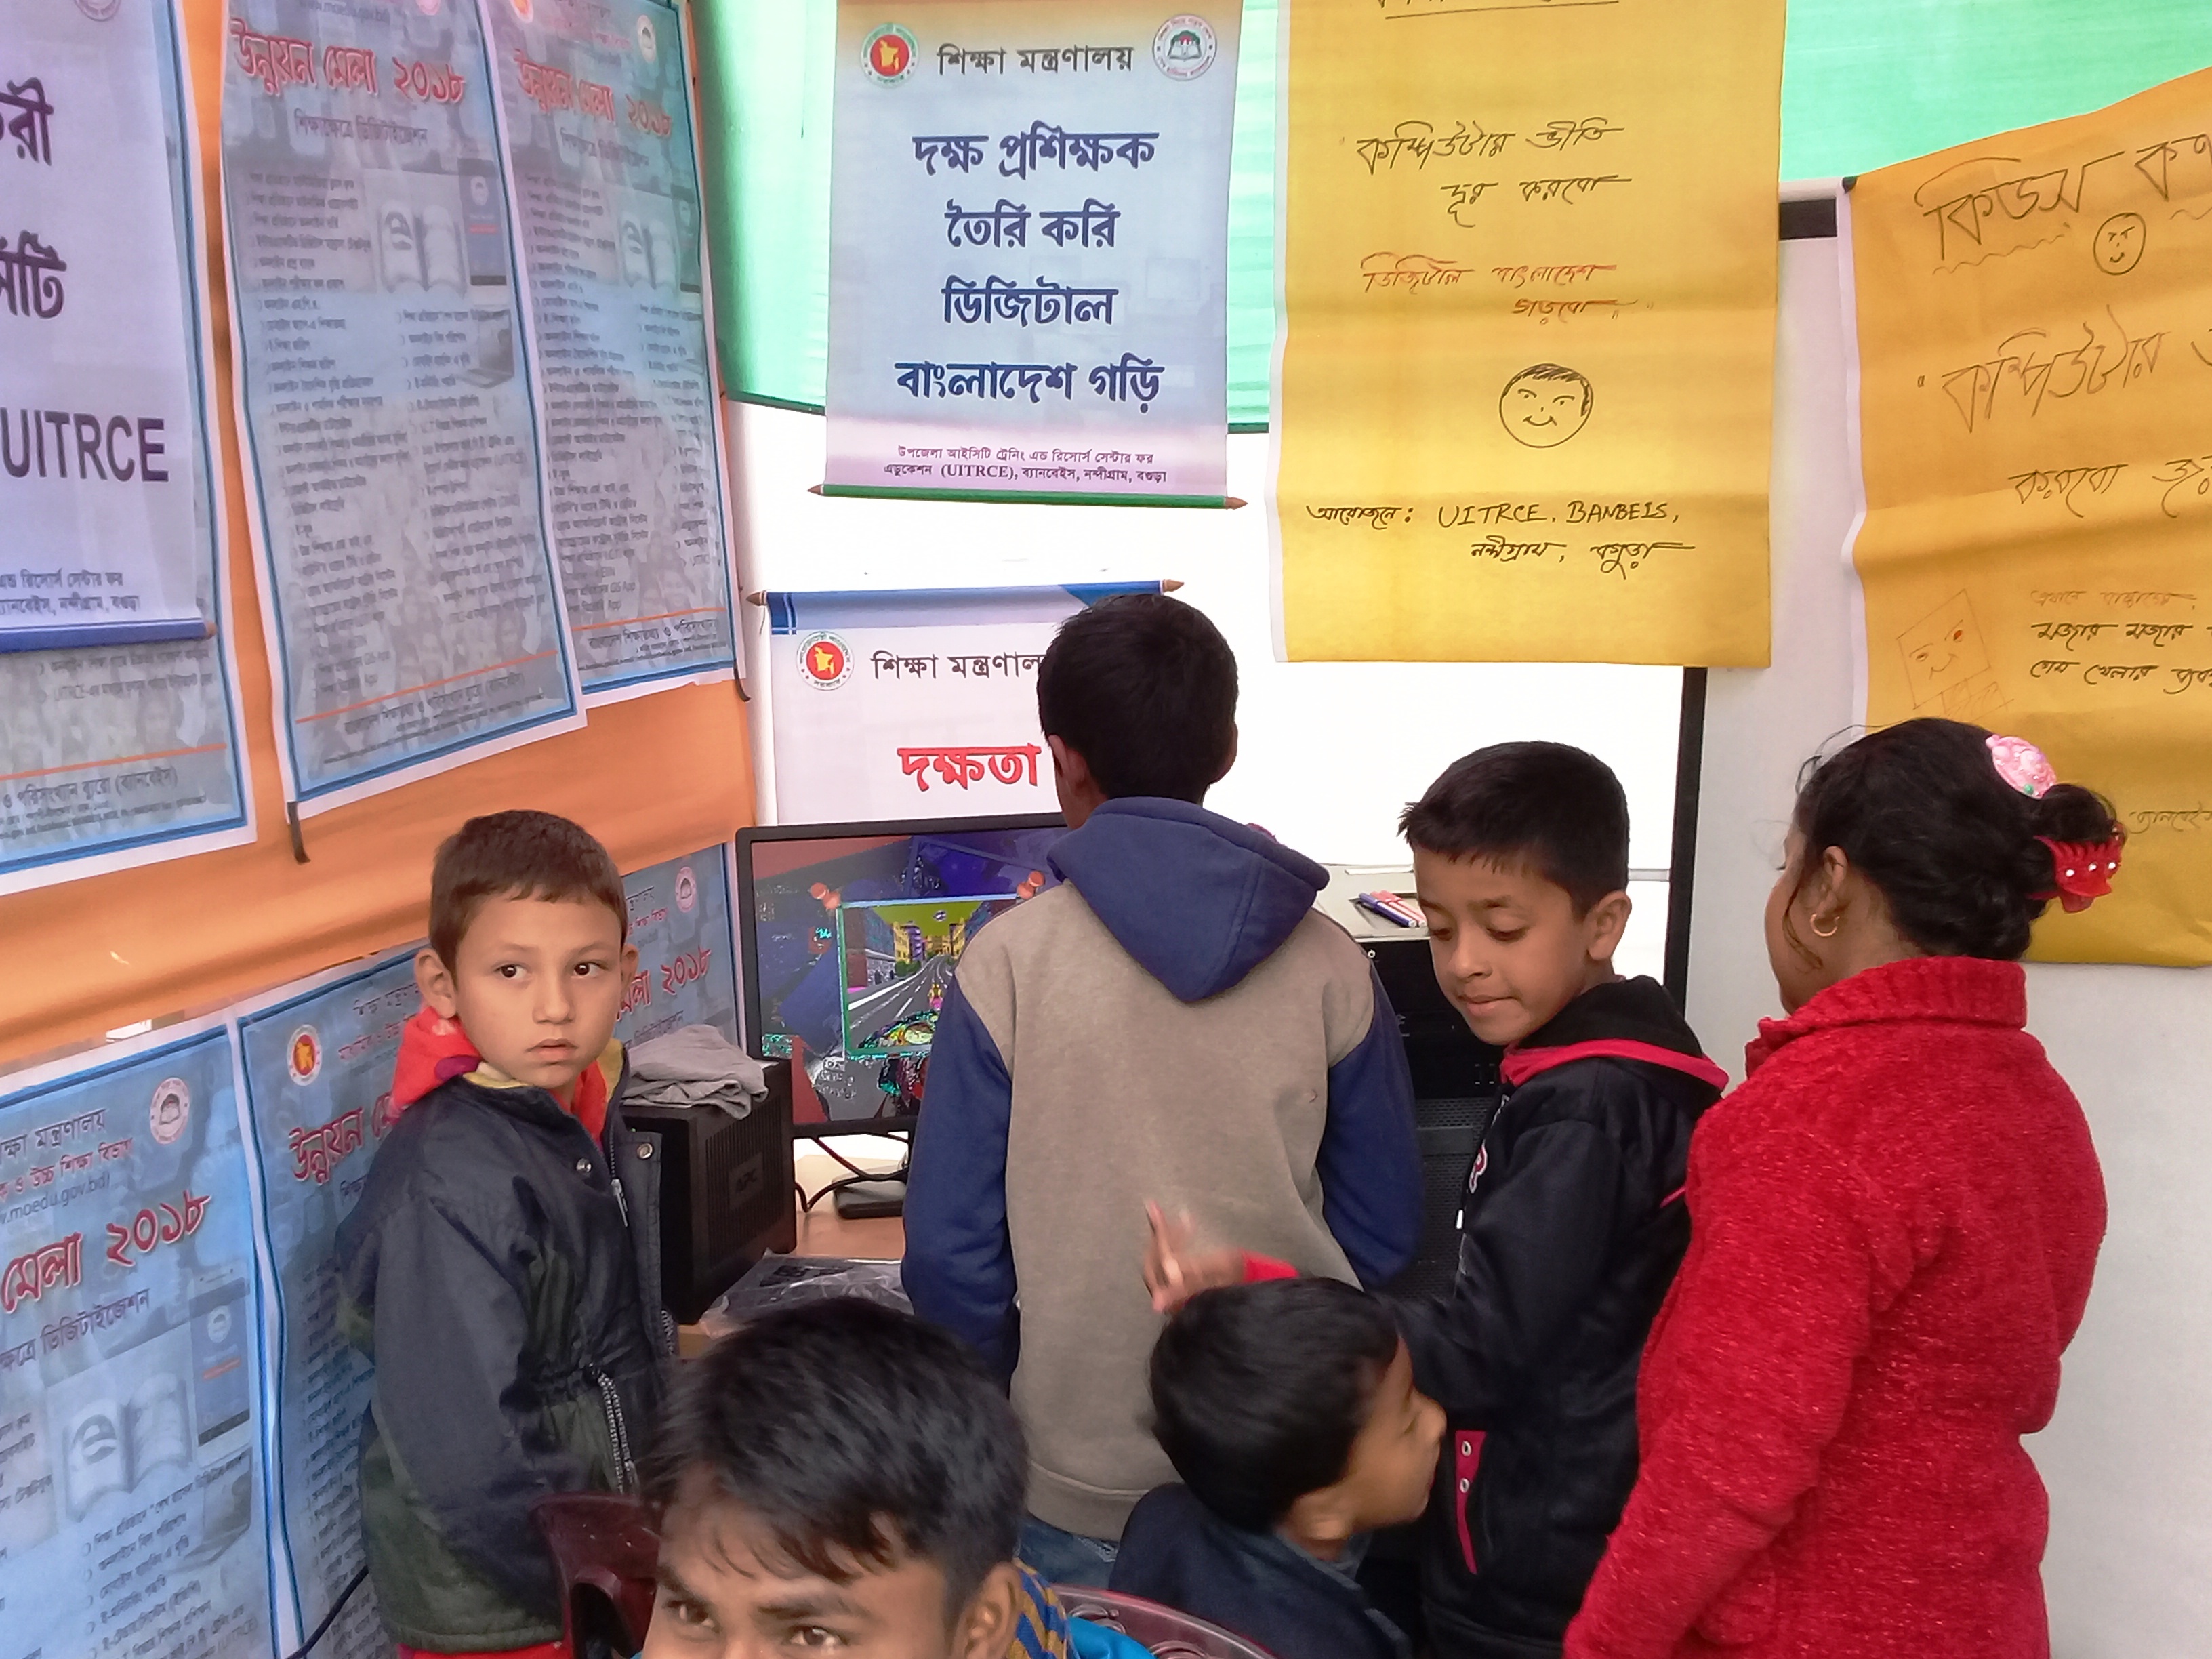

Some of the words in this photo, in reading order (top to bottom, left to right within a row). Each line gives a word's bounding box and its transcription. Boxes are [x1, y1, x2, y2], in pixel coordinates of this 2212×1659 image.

[323, 45, 378, 96] মেলা
[392, 56, 466, 102] ২০১৮
[937, 43, 1006, 76] শিক্ষা
[1017, 44, 1134, 74] মন্ত্রণালয়
[912, 135, 989, 176] দক্ষ
[999, 120, 1160, 180] প্রশিক্ষক
[1525, 117, 1624, 151] ভীতি
[1519, 175, 1632, 205] করবো
[944, 199, 1031, 248] তৈরি
[1039, 199, 1121, 248] করি
[941, 274, 1119, 327] ডিজিটাল
[894, 360, 1078, 405] বাংলাদেশ
[1089, 352, 1165, 414] গড়ি
[1, 408, 169, 483] UITRCE
[898, 445, 943, 458] উপজেলা
[947, 447, 991, 460] আইসিটি
[996, 447, 1025, 462] ট্রেনিং
[1052, 449, 1092, 462] রিসোর্স
[1095, 451, 1132, 464] সেন্টার
[1135, 453, 1154, 464] ফর
[941, 464, 1018, 480] (UITRCE),
[2008, 464, 2128, 518] করবো
[2031, 622, 2119, 651] মজার
[2126, 621, 2194, 647] মজার
[870, 649, 939, 680] শিক্ষা
[947, 651, 1048, 678] মন্ত্রণাল
[2030, 660, 2081, 678] গেম
[2083, 664, 2159, 685] খেলার
[897, 743, 1042, 792] দক্ষতা
[660, 945, 712, 996] ২০১৮
[0, 1232, 83, 1313] মেলা
[106, 1189, 213, 1267] ২০১৮
